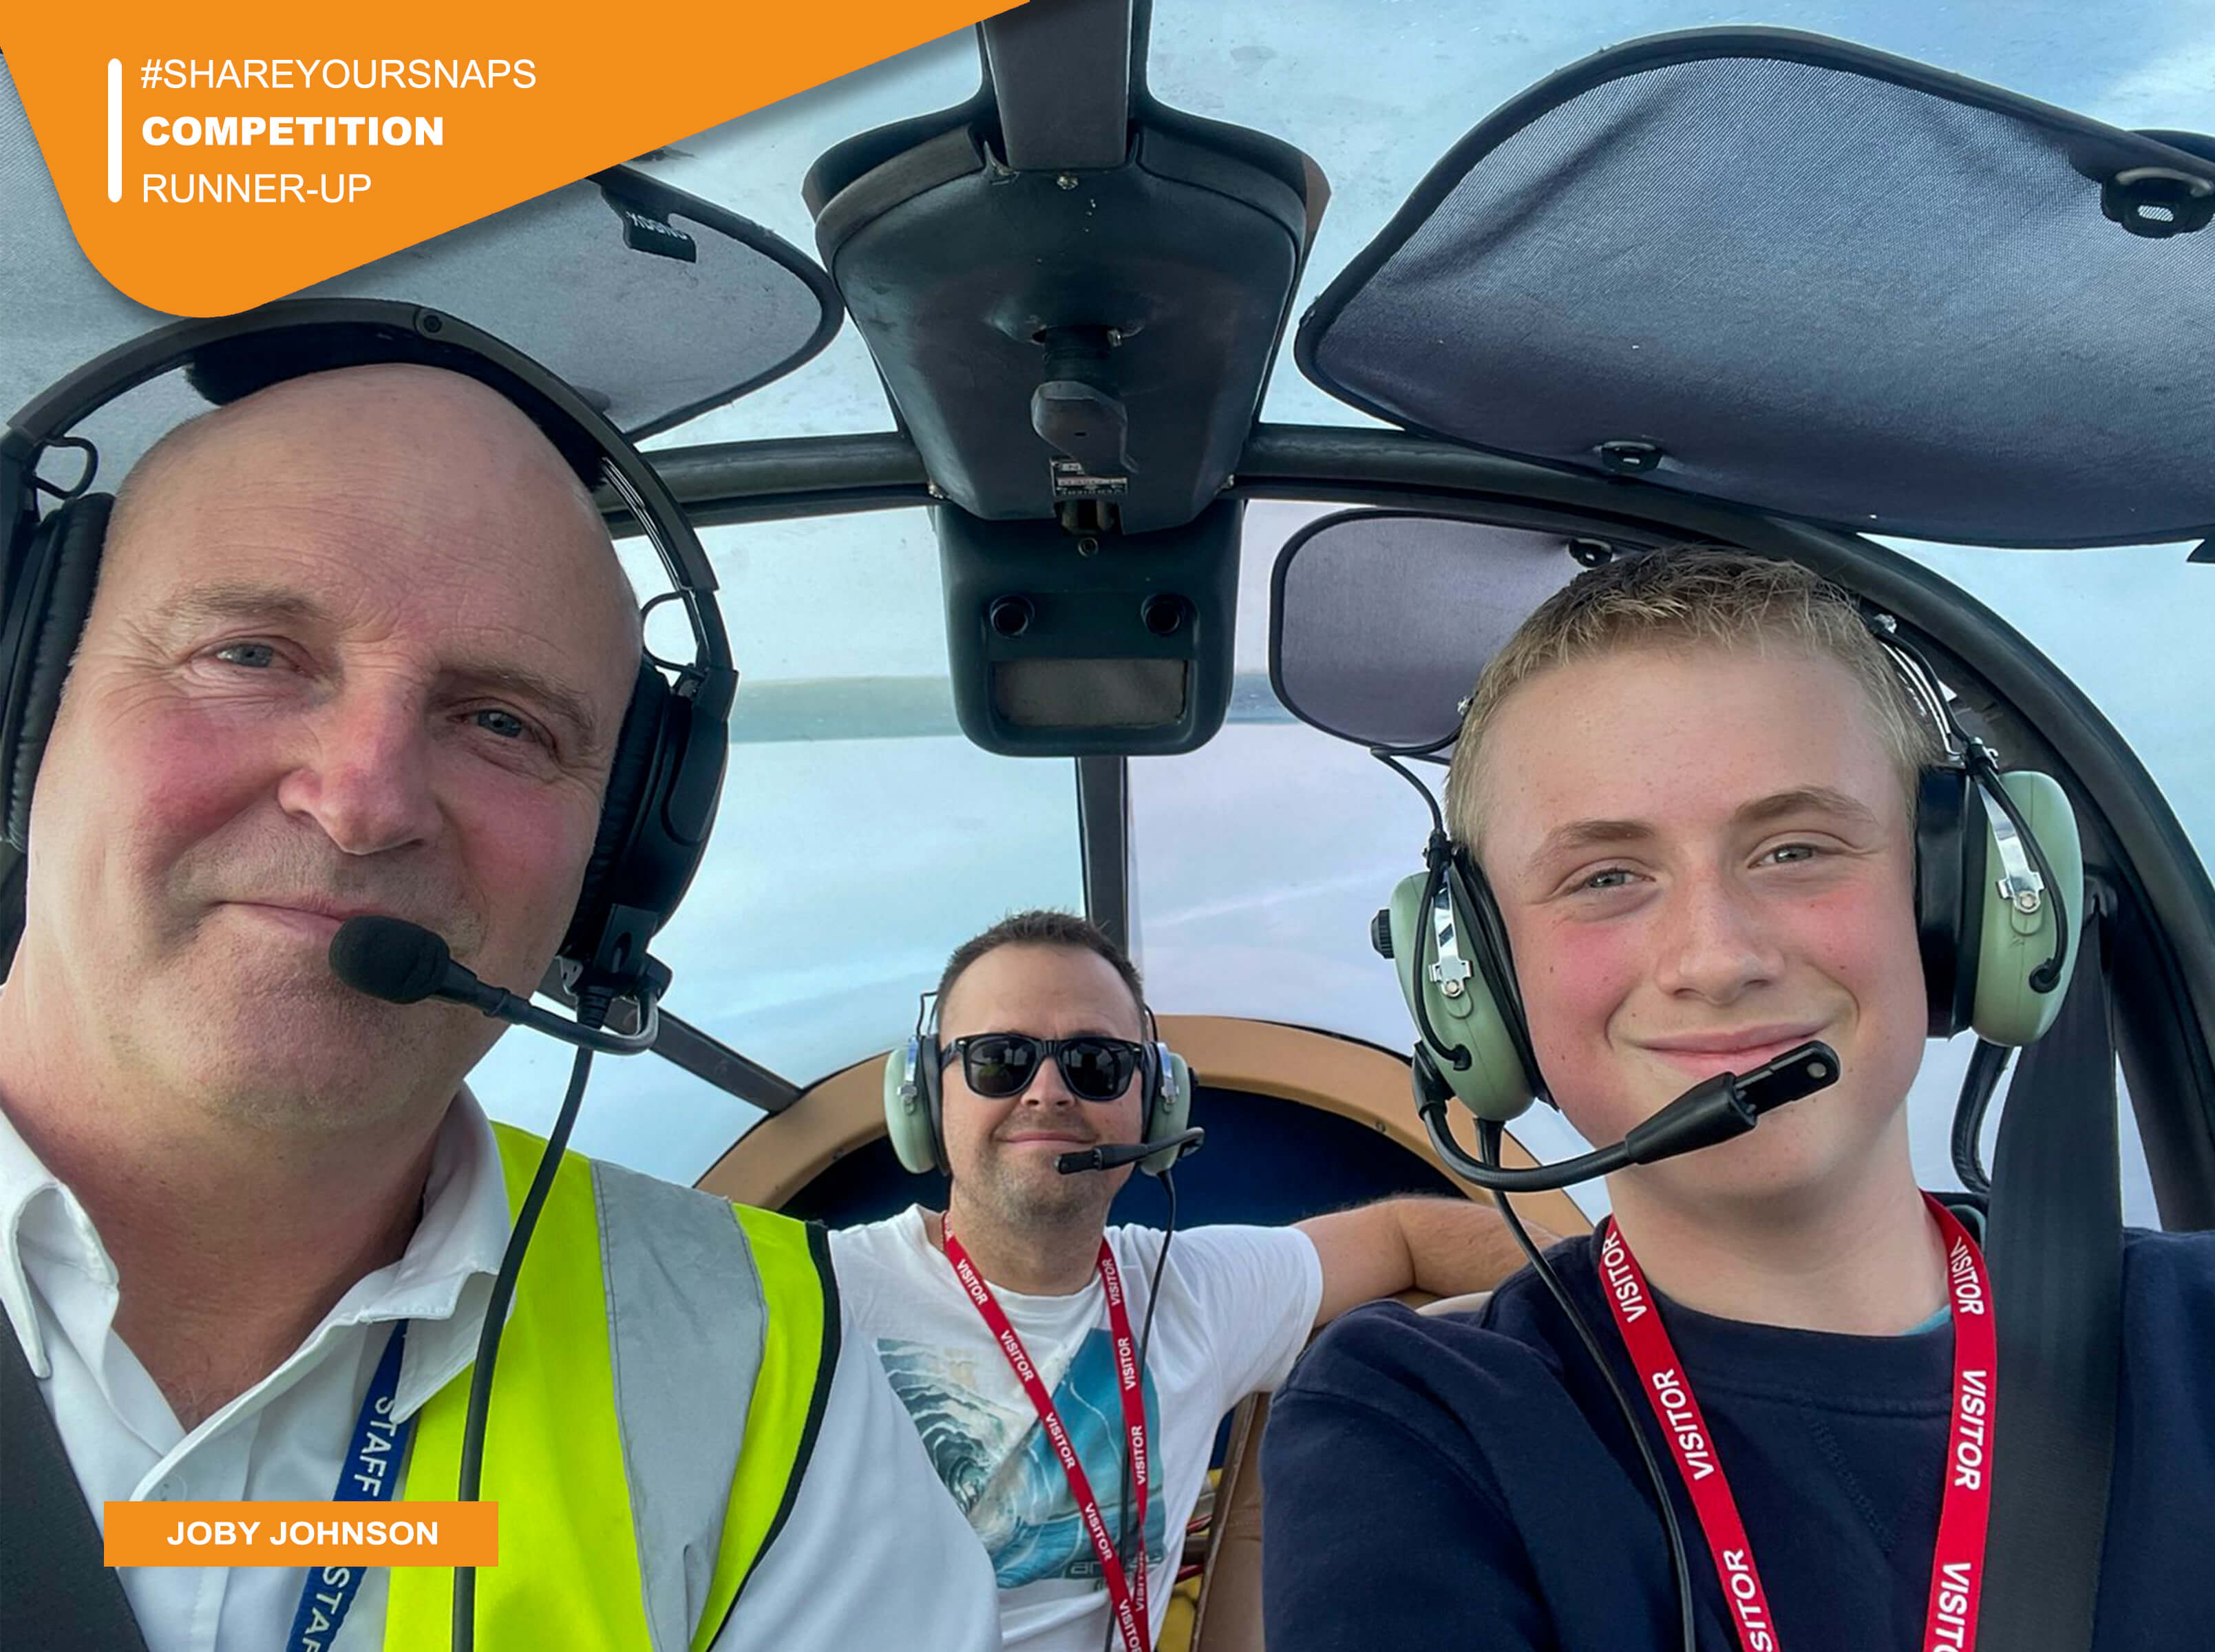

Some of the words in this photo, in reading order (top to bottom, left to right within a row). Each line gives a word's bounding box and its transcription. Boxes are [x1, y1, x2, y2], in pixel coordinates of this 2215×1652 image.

[957, 1259, 988, 1305] VISITOR
[1103, 1259, 1121, 1306] VISITOR
[1602, 1231, 1646, 1323] VISITOR
[1950, 1236, 1984, 1315] VISITOR
[1001, 1331, 1034, 1381] VISITOR
[1118, 1337, 1136, 1390] VISITOR
[354, 1396, 397, 1497] STAFF
[1046, 1412, 1075, 1469] VISITOR
[1652, 1368, 1715, 1481] VISITOR
[1954, 1370, 1987, 1491] VISITOR
[1131, 1426, 1145, 1485] VISITOR
[1085, 1503, 1112, 1560] VISITOR
